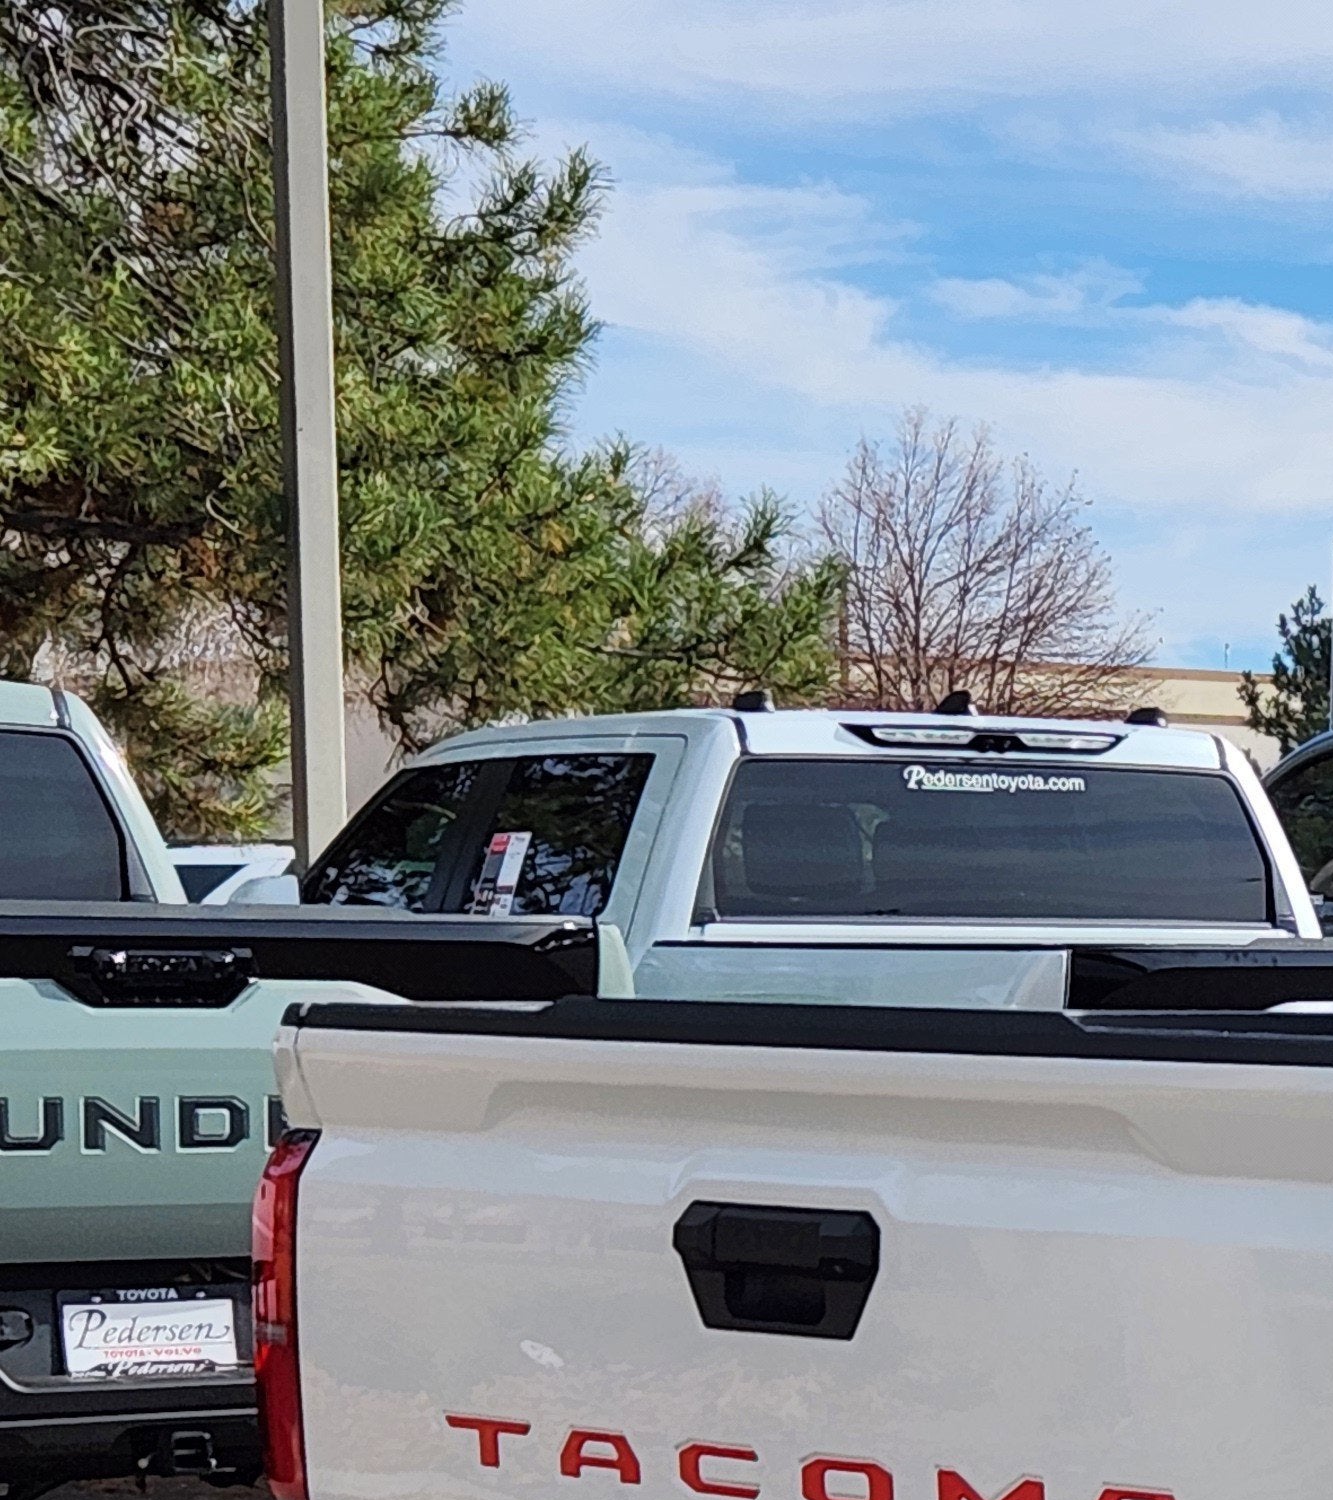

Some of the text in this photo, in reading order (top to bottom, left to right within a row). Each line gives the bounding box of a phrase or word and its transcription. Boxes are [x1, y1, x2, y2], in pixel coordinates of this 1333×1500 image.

[903, 765, 1085, 792] Pedersentoyota.com
[116, 1288, 178, 1301] TOYOTA
[69, 1309, 230, 1349] Pedersen
